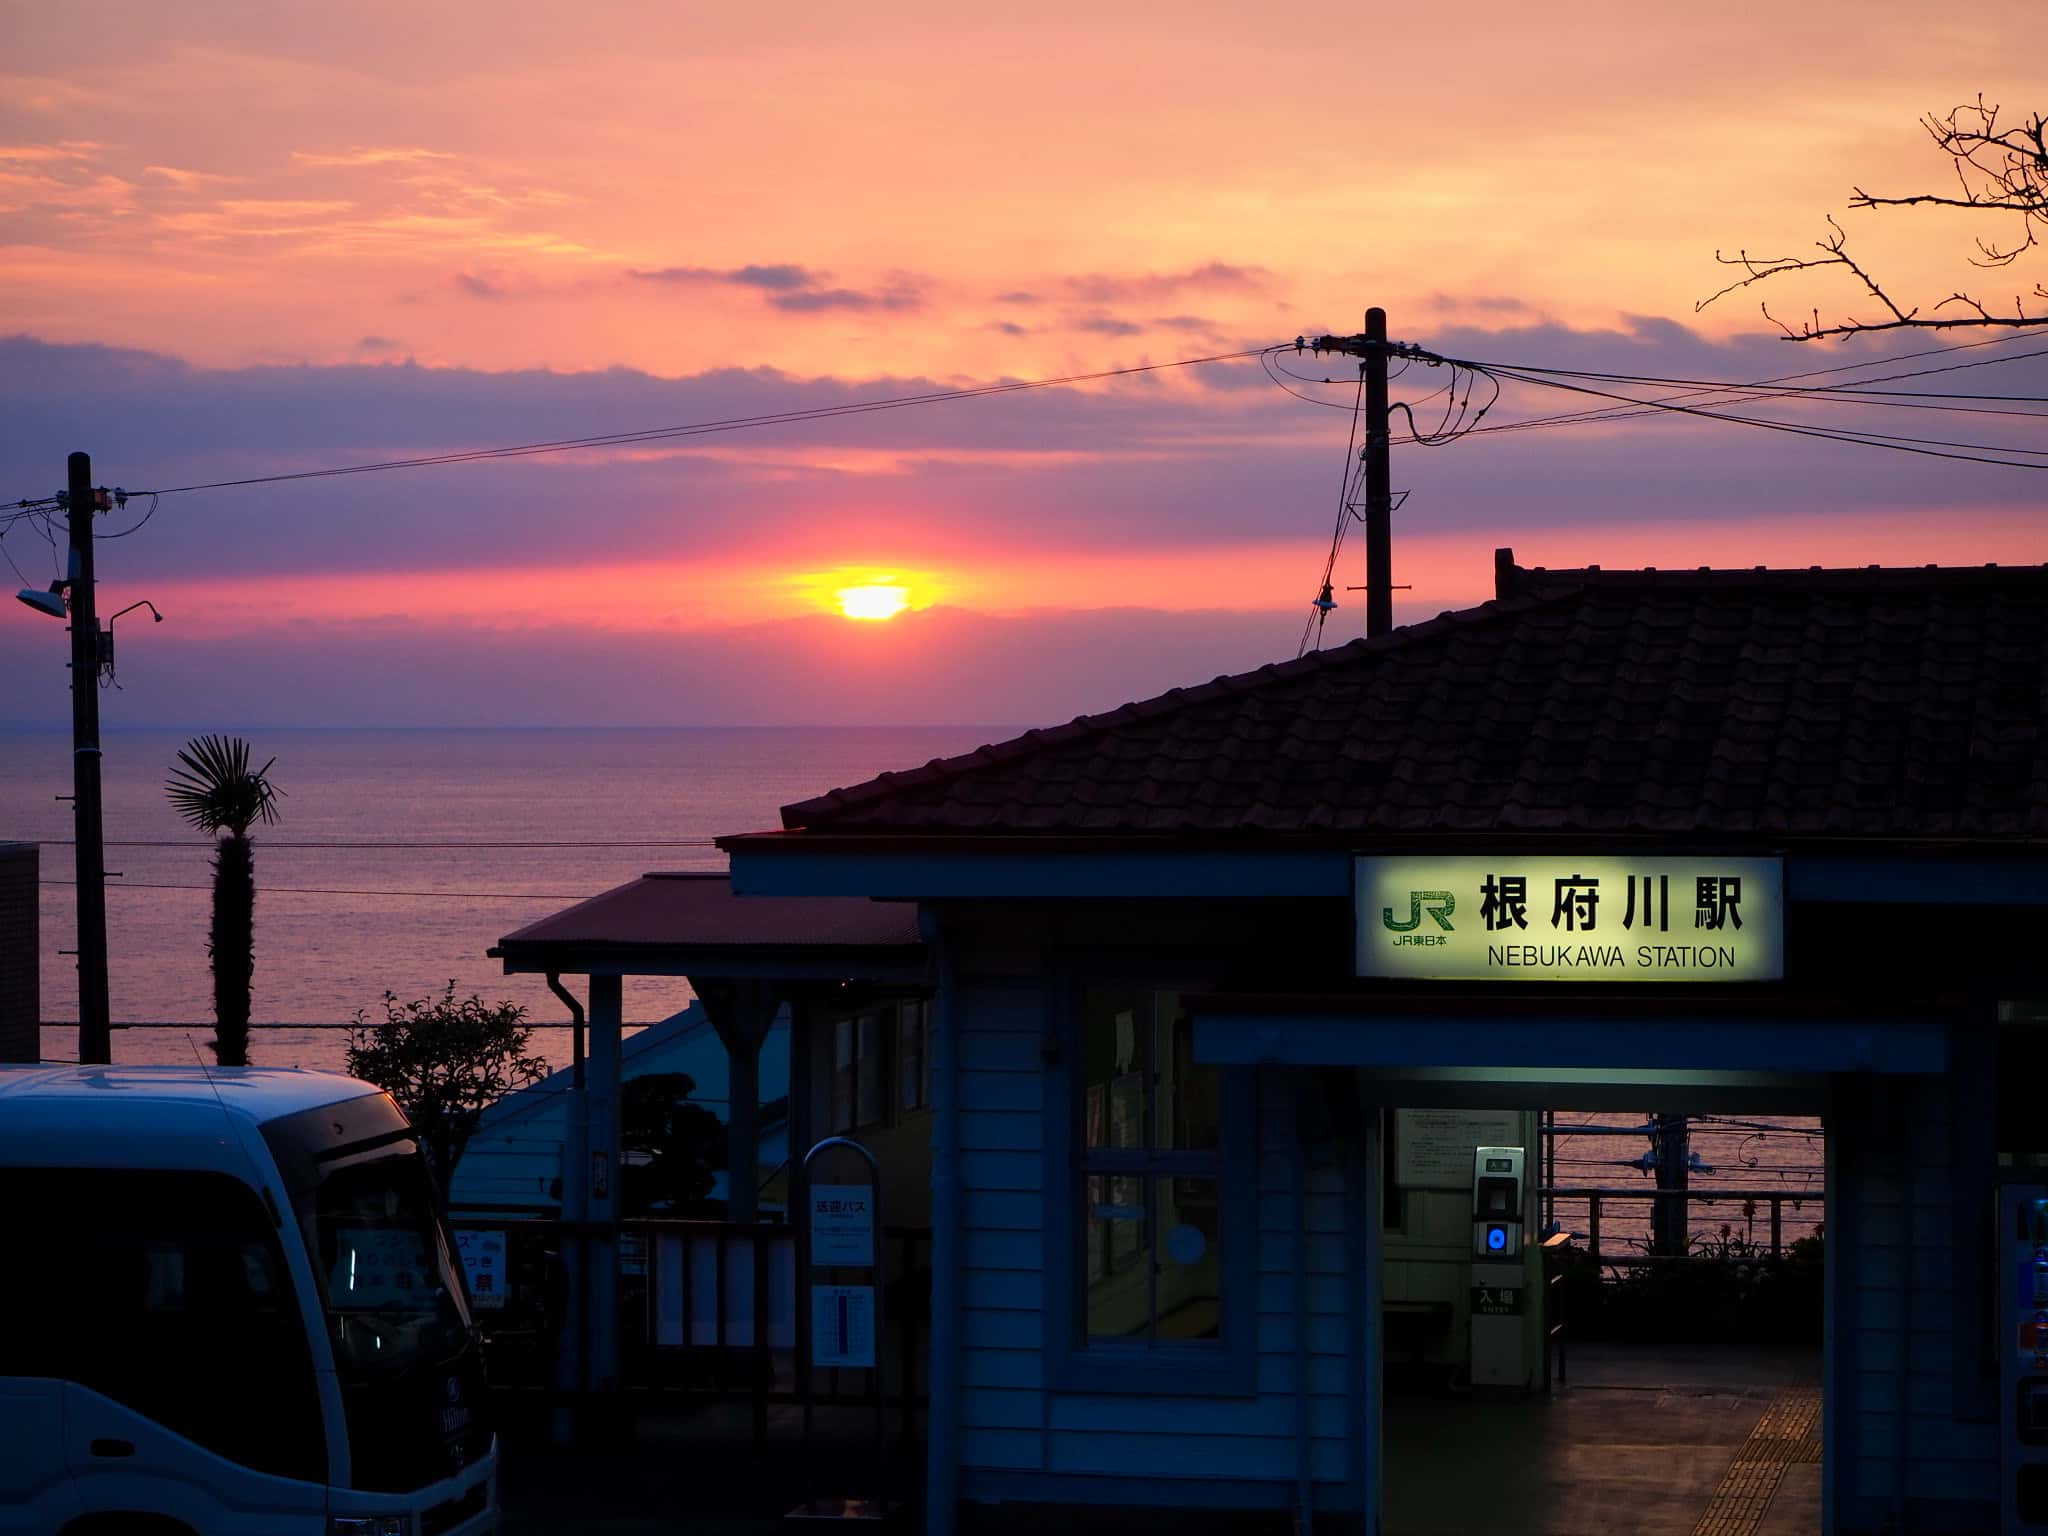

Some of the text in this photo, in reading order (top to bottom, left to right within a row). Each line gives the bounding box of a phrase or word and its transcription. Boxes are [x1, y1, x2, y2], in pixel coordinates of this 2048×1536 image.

[1383, 891, 1456, 932] JR
[1480, 874, 1743, 932] 根府川駅
[1392, 936, 1447, 946] JR東日本
[1488, 945, 1735, 968] NEBUKAWA STATION
